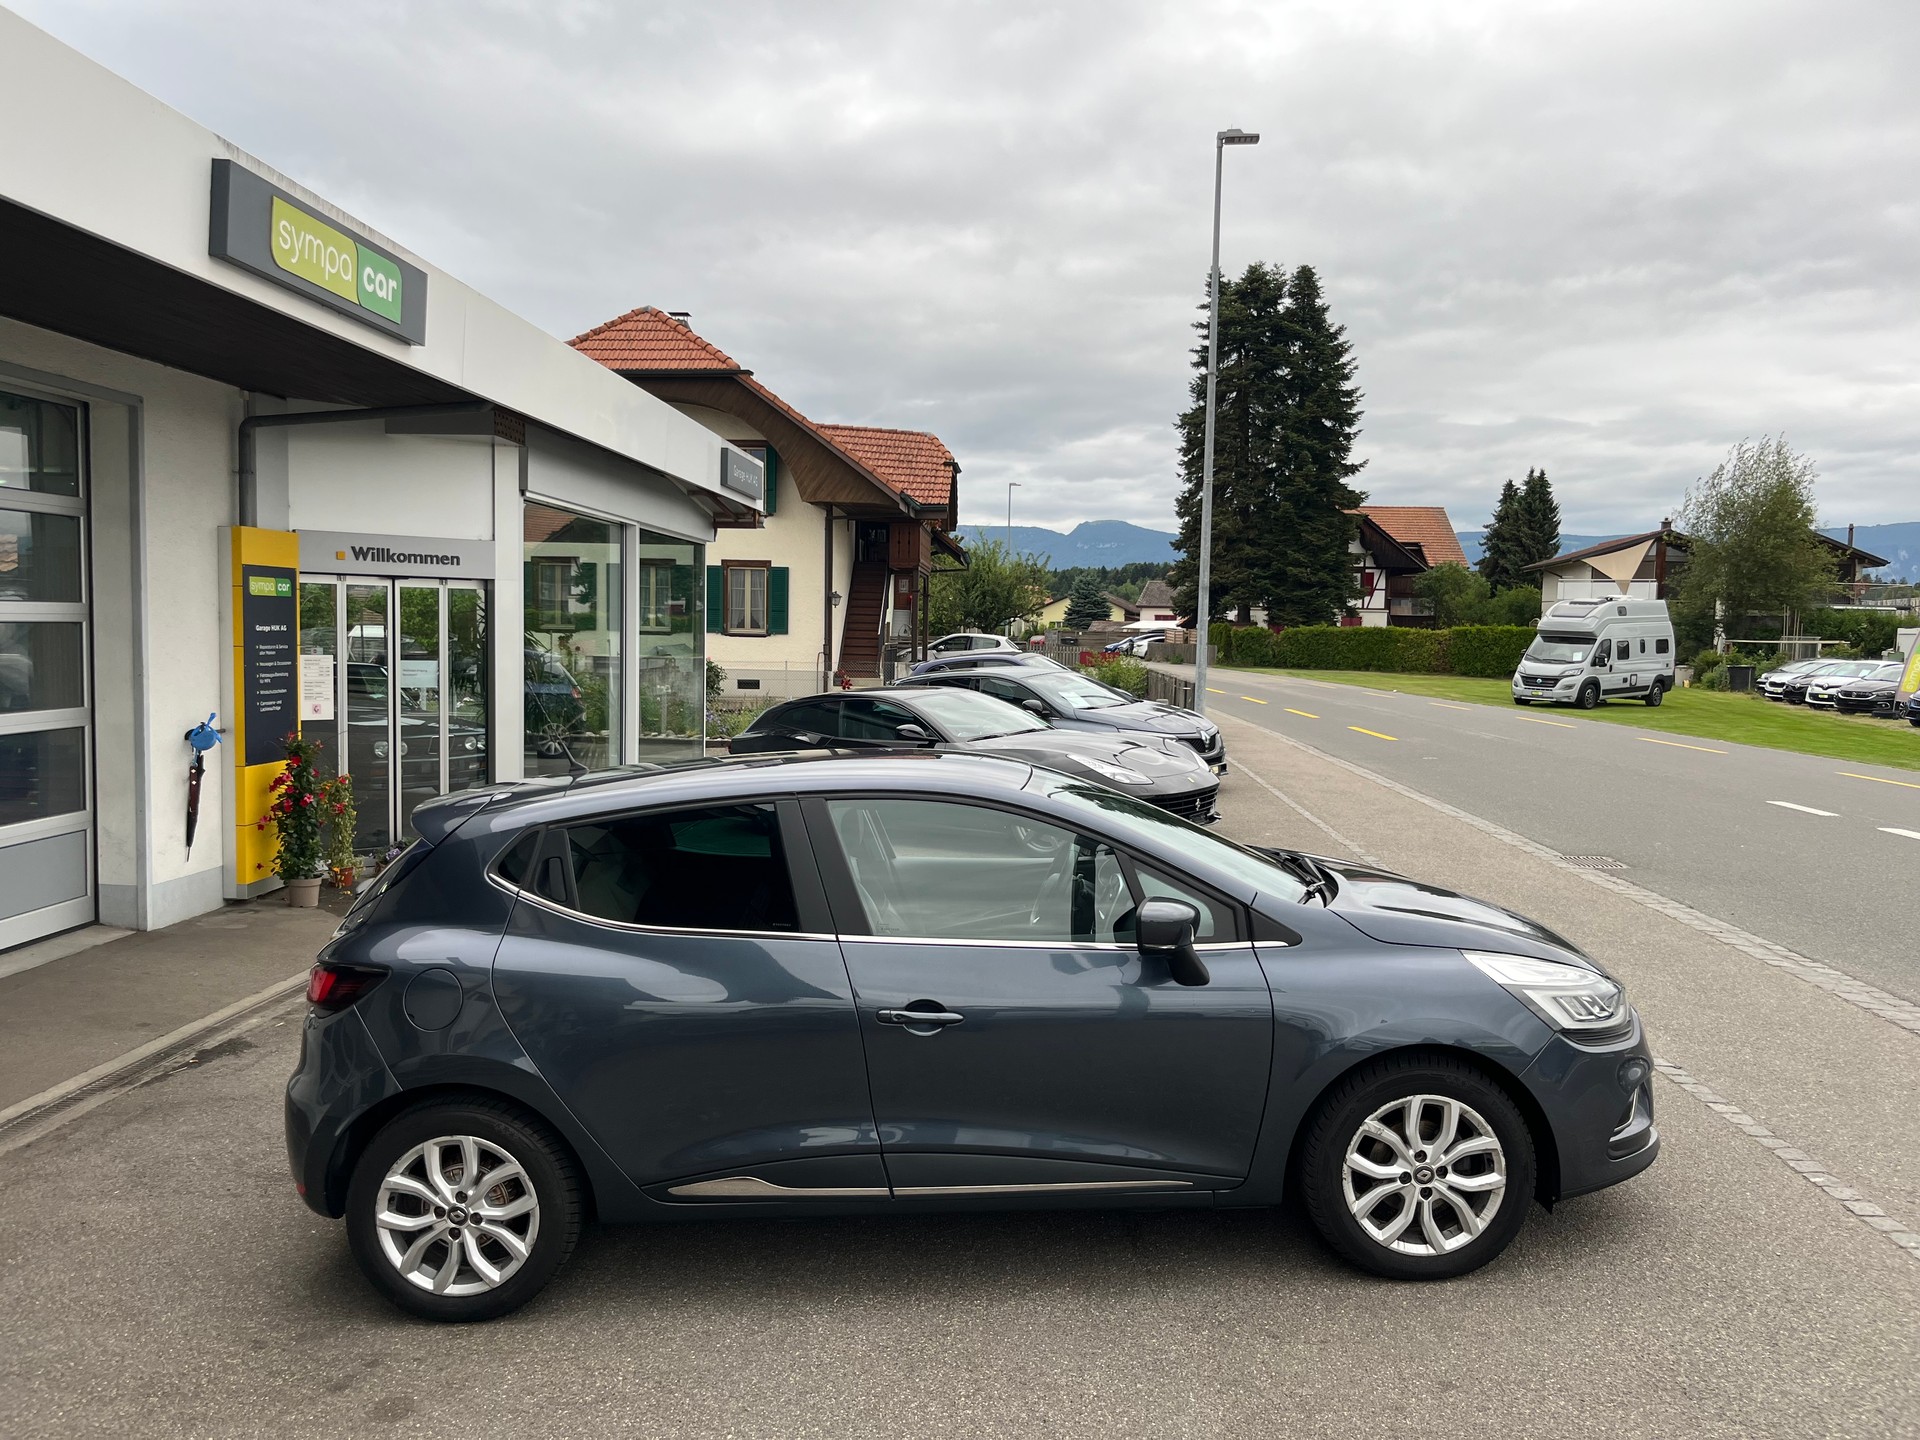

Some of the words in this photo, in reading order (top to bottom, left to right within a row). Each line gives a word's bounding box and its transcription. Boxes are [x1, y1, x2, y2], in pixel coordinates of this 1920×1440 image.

[278, 219, 352, 282] sympa
[363, 266, 397, 302] car
[350, 545, 461, 566] Willkommen
[251, 581, 275, 593] sympa
[277, 583, 290, 592] car
[255, 624, 271, 633] Garage
[280, 624, 287, 632] AG
